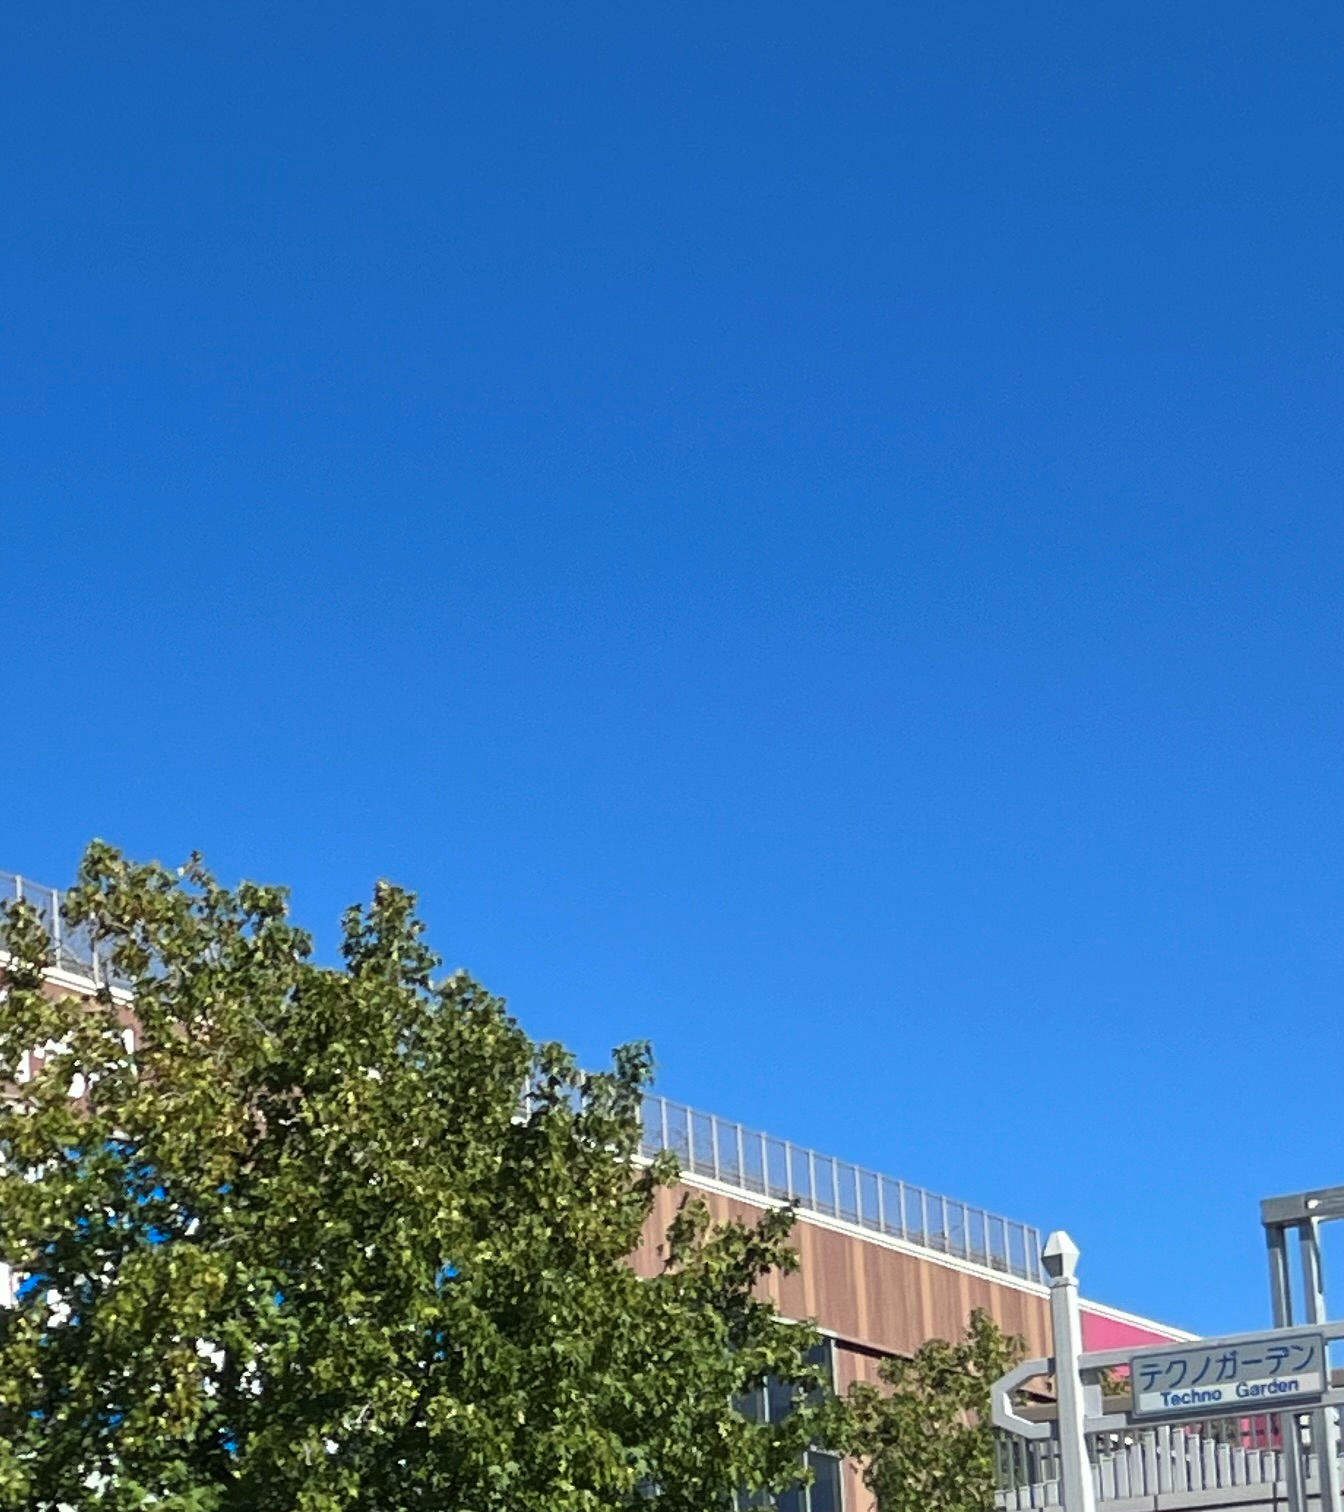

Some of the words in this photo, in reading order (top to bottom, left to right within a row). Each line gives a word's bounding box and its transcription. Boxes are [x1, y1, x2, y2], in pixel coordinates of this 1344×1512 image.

[1139, 1344, 1315, 1391] テクノガーデン
[1160, 1387, 1222, 1407] Techno
[1235, 1378, 1299, 1398] Garden
